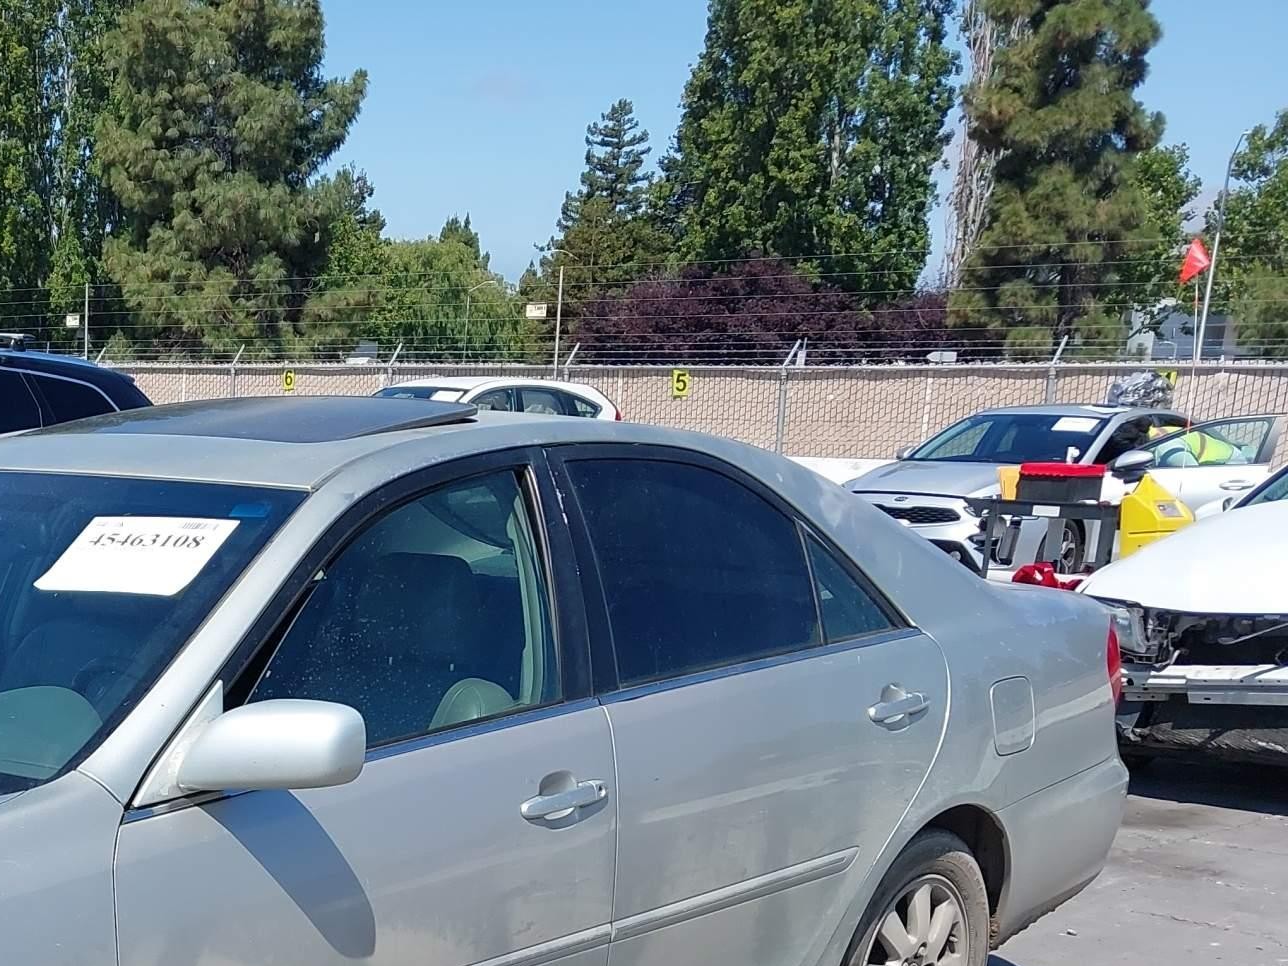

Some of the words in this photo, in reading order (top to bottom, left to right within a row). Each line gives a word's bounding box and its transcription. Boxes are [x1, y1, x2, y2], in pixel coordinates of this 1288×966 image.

[285, 370, 293, 386] 6
[675, 373, 687, 392] 5
[89, 532, 205, 549] 45463108
